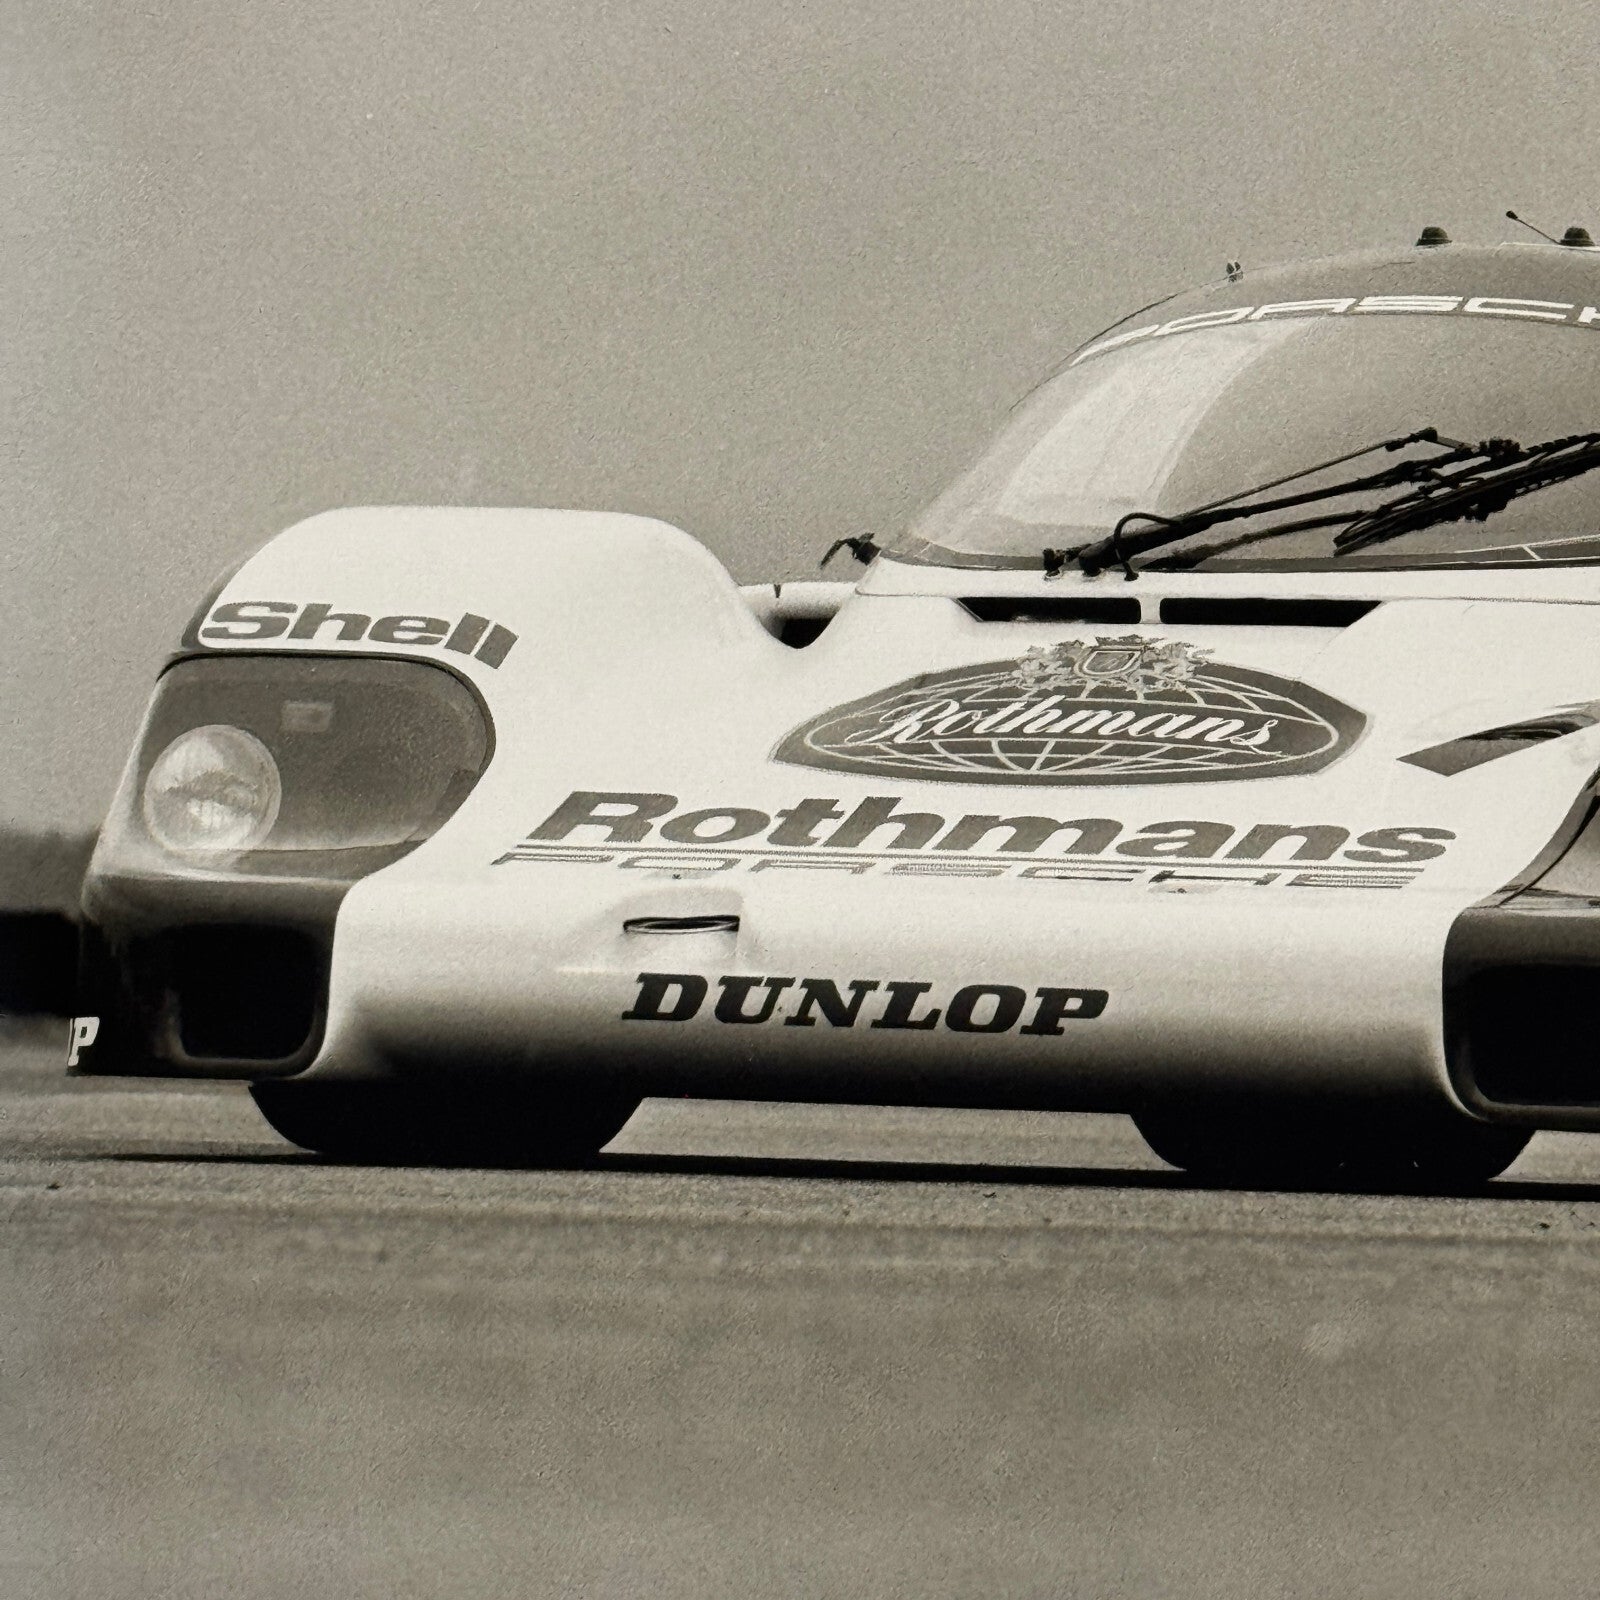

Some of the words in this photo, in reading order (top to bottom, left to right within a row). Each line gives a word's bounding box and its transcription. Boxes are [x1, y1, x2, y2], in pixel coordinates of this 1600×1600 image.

[1069, 295, 1600, 367] PORSC
[201, 601, 520, 670] Shell
[845, 694, 1283, 756] Rothmans
[525, 790, 1457, 863] Rothmans
[490, 852, 1418, 889] PORSCHE
[621, 972, 1110, 1036] DUNLOP
[68, 1016, 100, 1067] P
